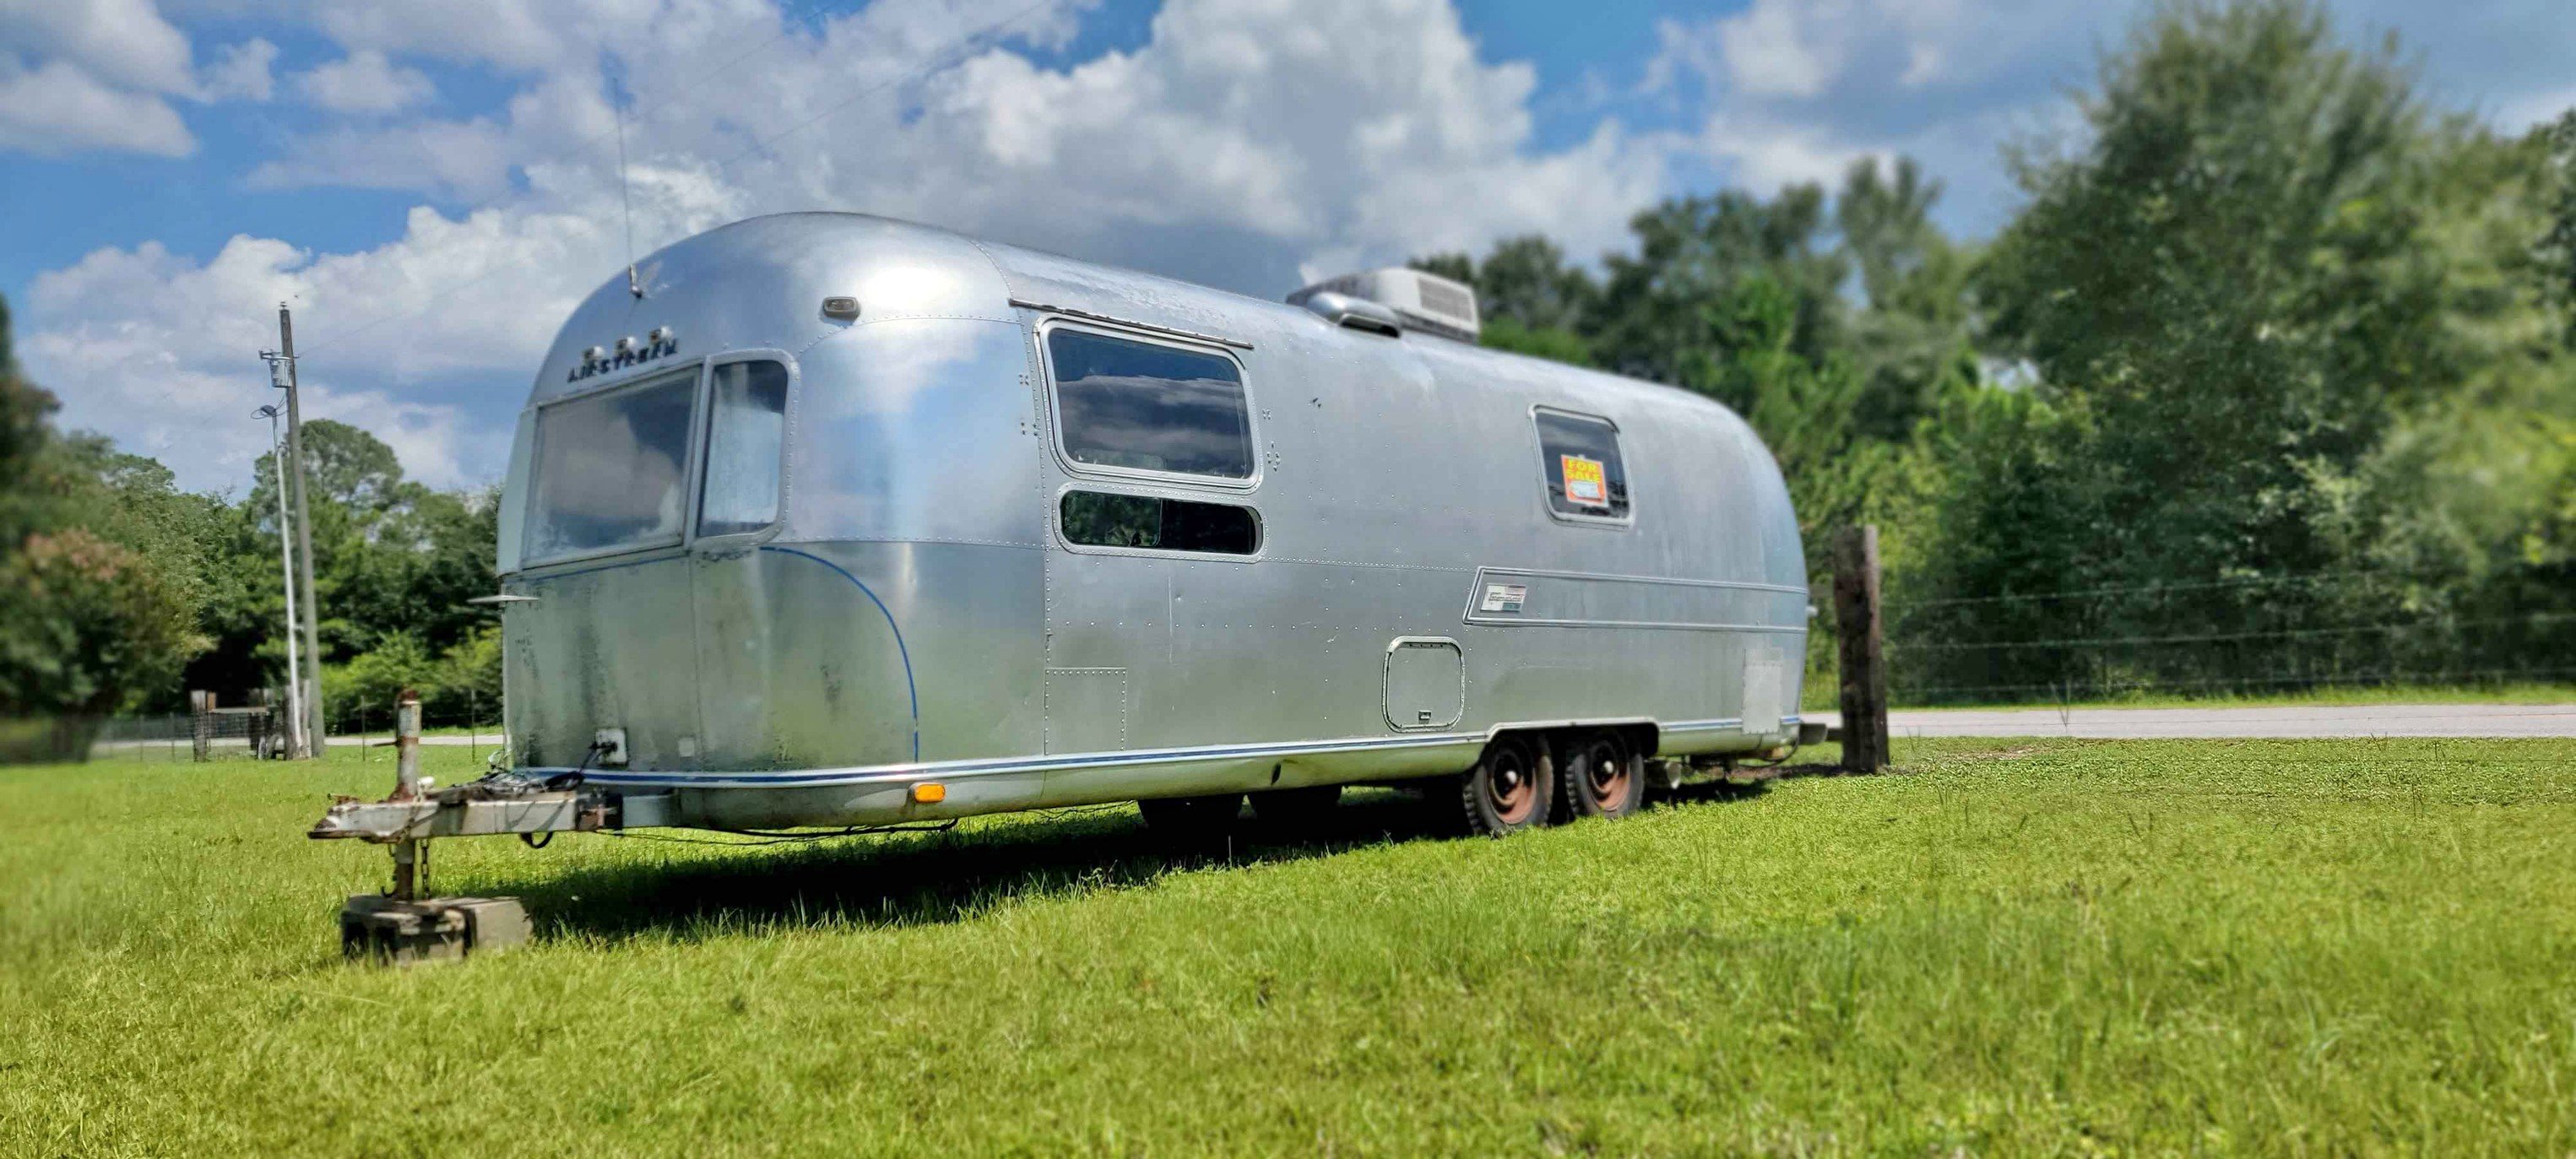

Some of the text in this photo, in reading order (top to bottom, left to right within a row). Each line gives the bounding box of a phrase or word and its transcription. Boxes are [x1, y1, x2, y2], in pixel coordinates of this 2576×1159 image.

[567, 338, 678, 382] AIRSTREAM
[1568, 458, 1597, 473] FOR
[1566, 469, 1600, 483] SALE
